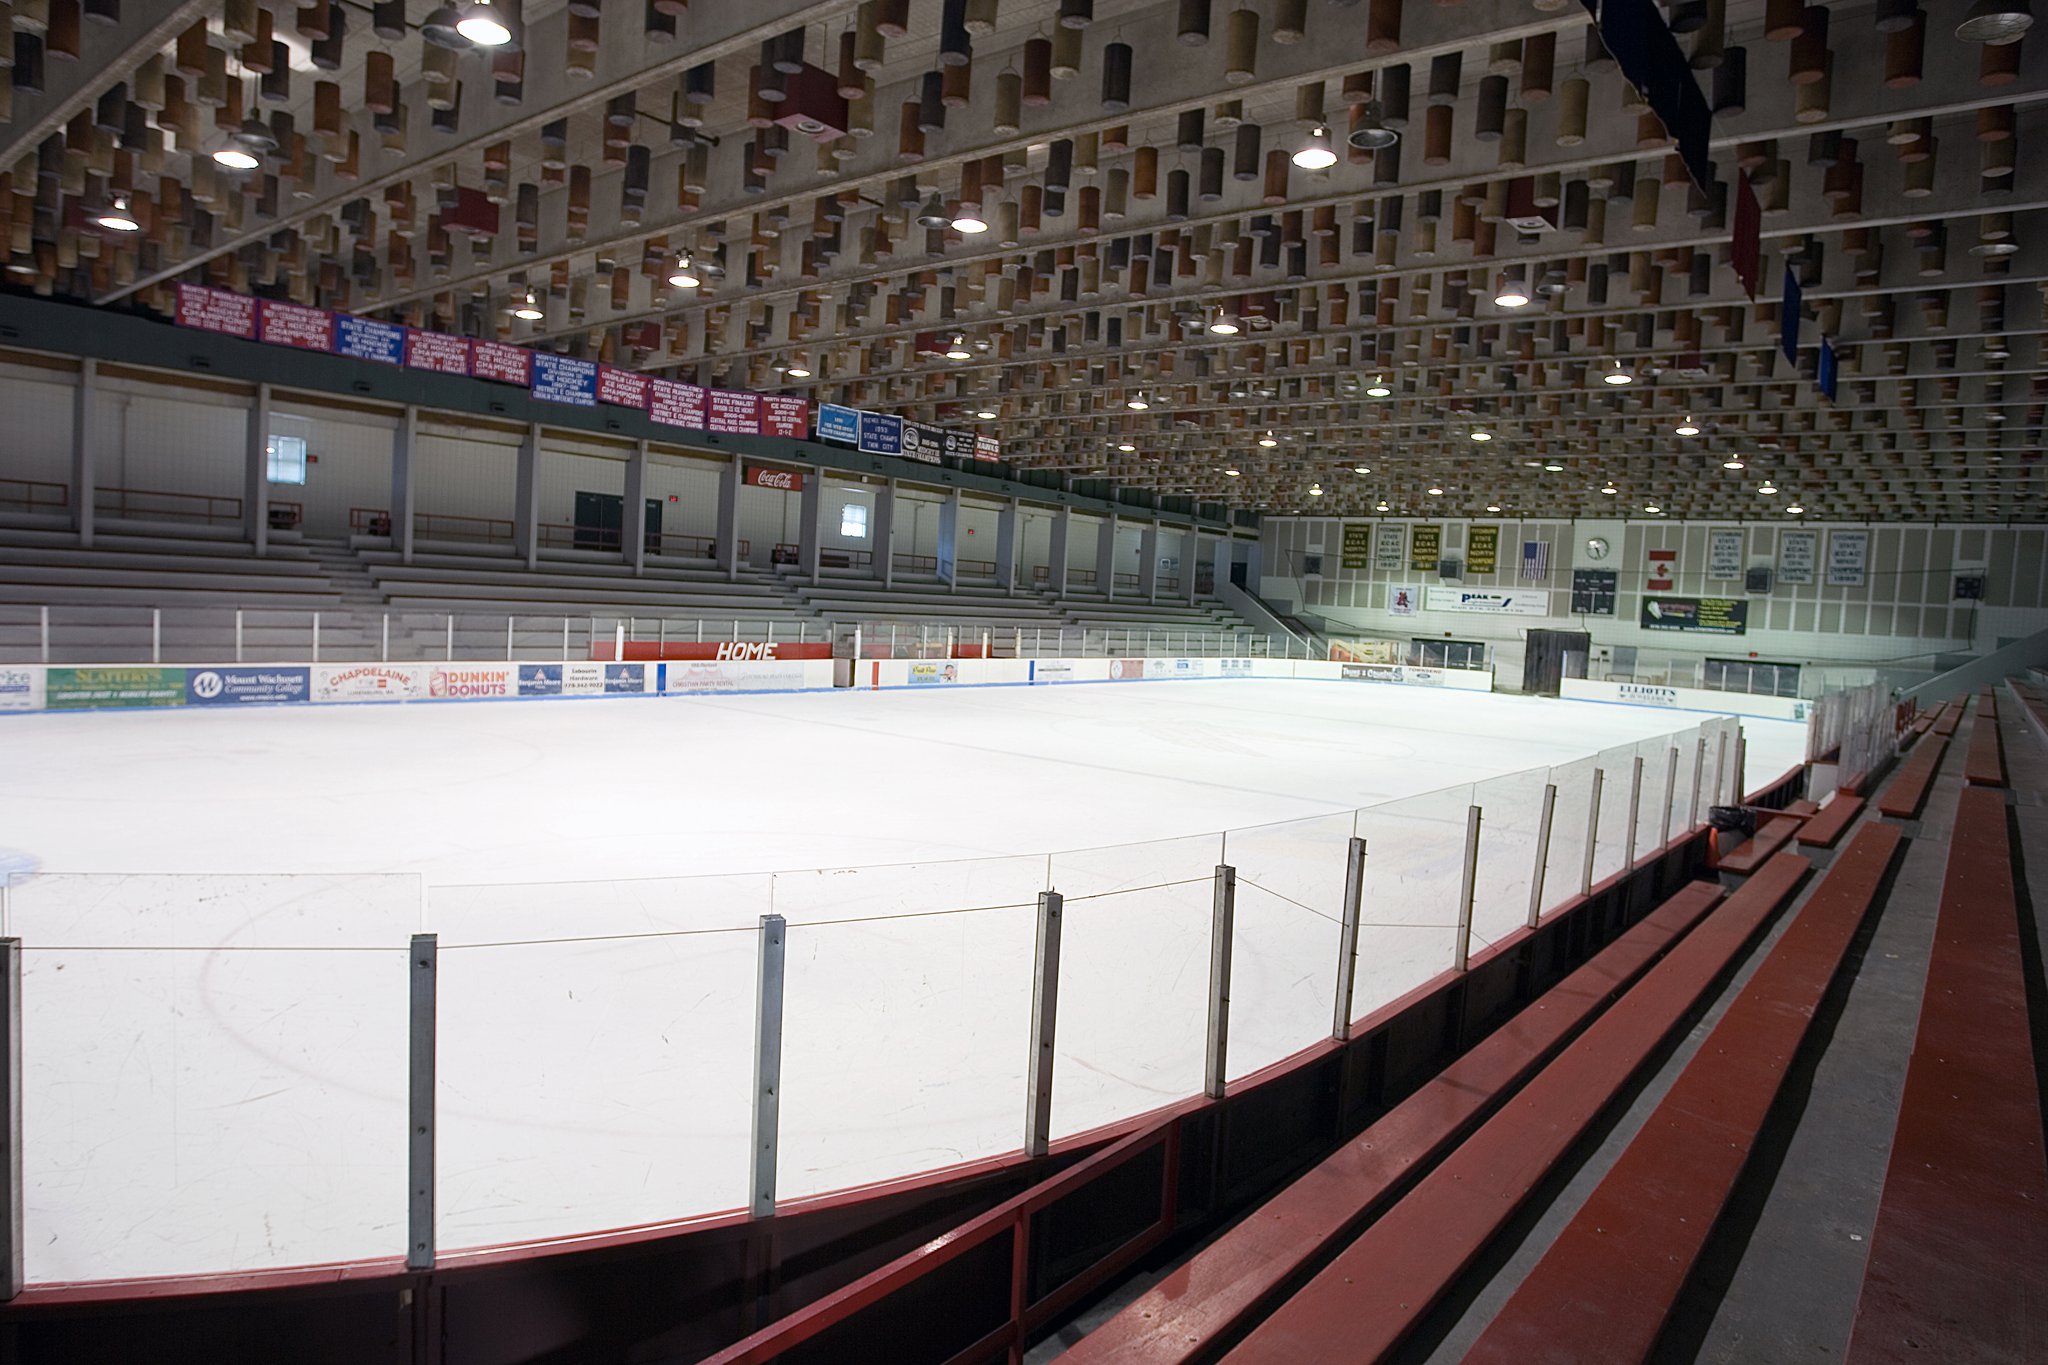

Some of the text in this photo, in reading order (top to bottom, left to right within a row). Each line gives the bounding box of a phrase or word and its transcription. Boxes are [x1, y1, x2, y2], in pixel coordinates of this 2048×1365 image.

[412, 347, 465, 362] CHAMPIONS
[430, 344, 462, 354] HOCKEY
[478, 354, 523, 368] ICE HOCKEY
[476, 360, 526, 376] CHAMPIONS
[536, 360, 595, 376] STATE CHAMPIONS
[542, 372, 589, 387] ICE HOCKEY
[605, 380, 641, 394] ICE HOCKEY
[602, 386, 643, 401] CHAMPIONS
[863, 432, 878, 440] STATE
[882, 443, 894, 451] CITY
[976, 441, 1000, 453] HAWKS
[1462, 594, 1488, 602] PEAK
[716, 642, 778, 660] HOME
[225, 674, 303, 684] Mount Wachusett
[448, 672, 509, 684] DUNKIN'
[518, 679, 544, 687] Benjamin
[224, 684, 303, 694] Community College
[448, 684, 506, 696] DONUTS
[1620, 685, 1676, 696] ELLIOTT'S
